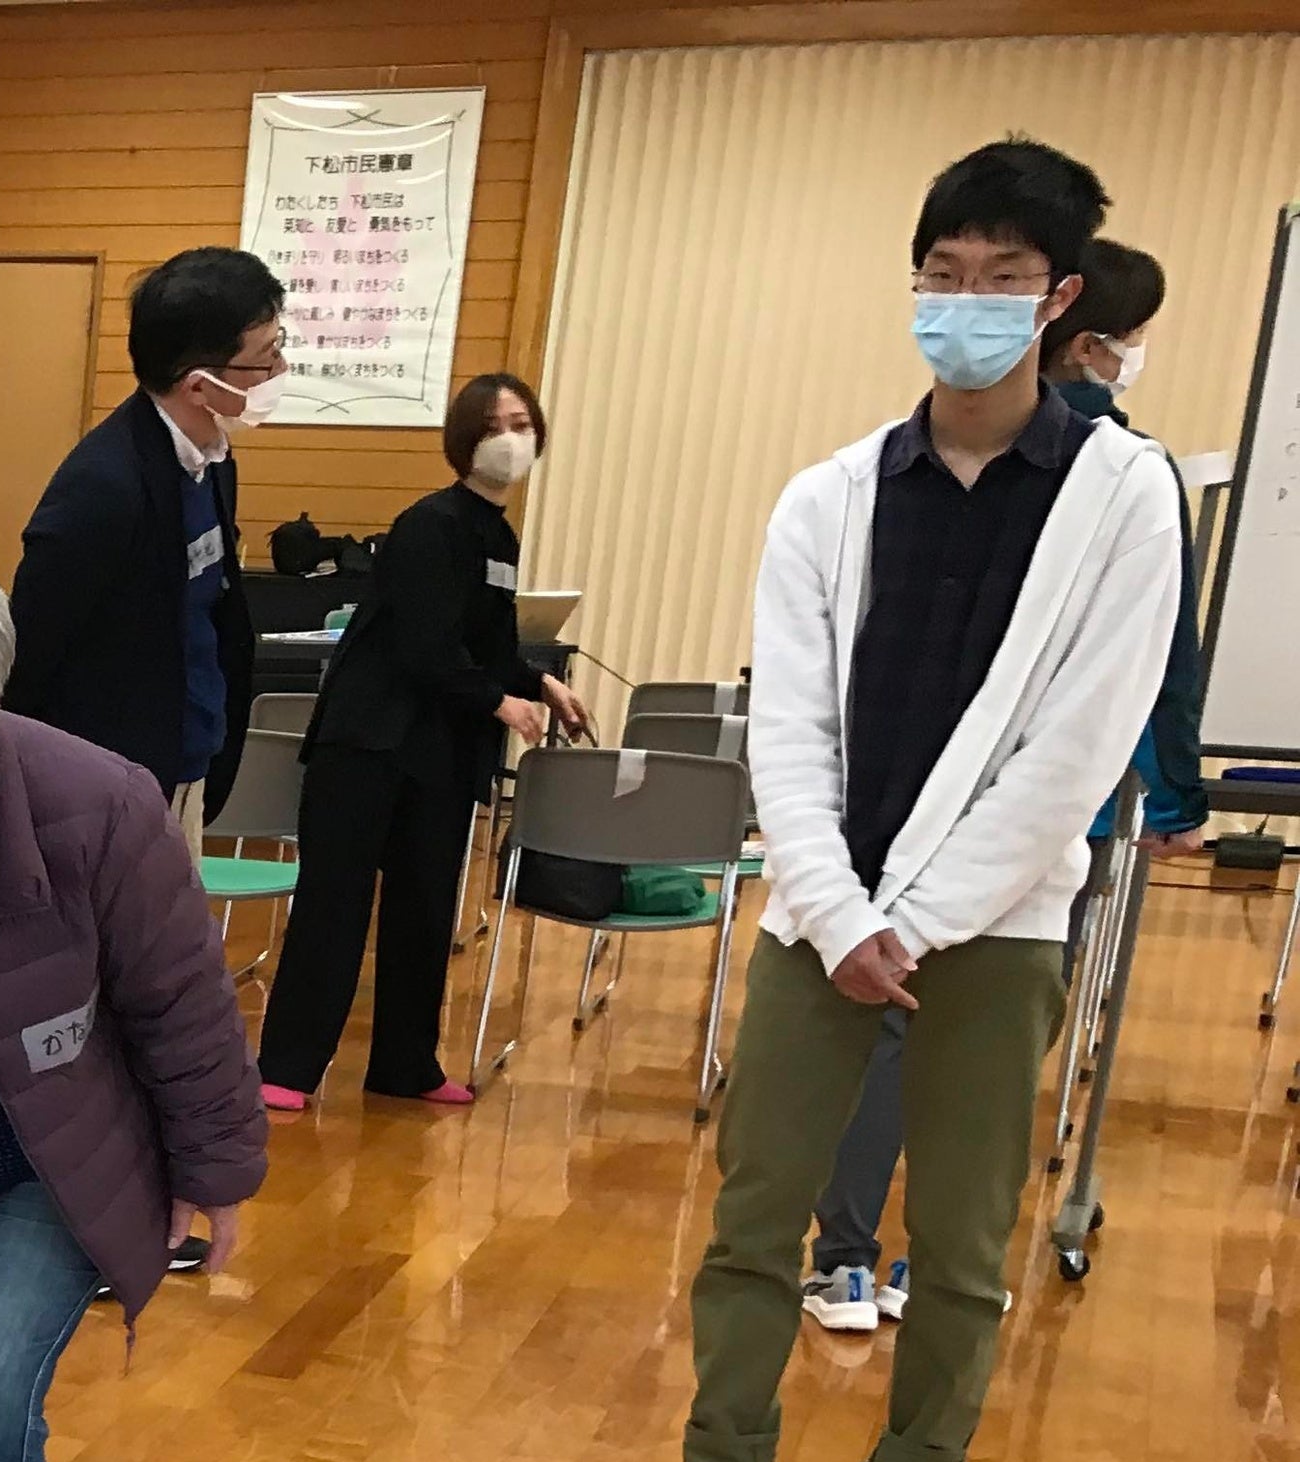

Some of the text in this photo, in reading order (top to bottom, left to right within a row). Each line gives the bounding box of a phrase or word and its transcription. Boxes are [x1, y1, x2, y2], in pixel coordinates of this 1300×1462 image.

[304, 154, 413, 174] 下松市民憲章
[275, 193, 405, 211] わたくしたち 下松市民は
